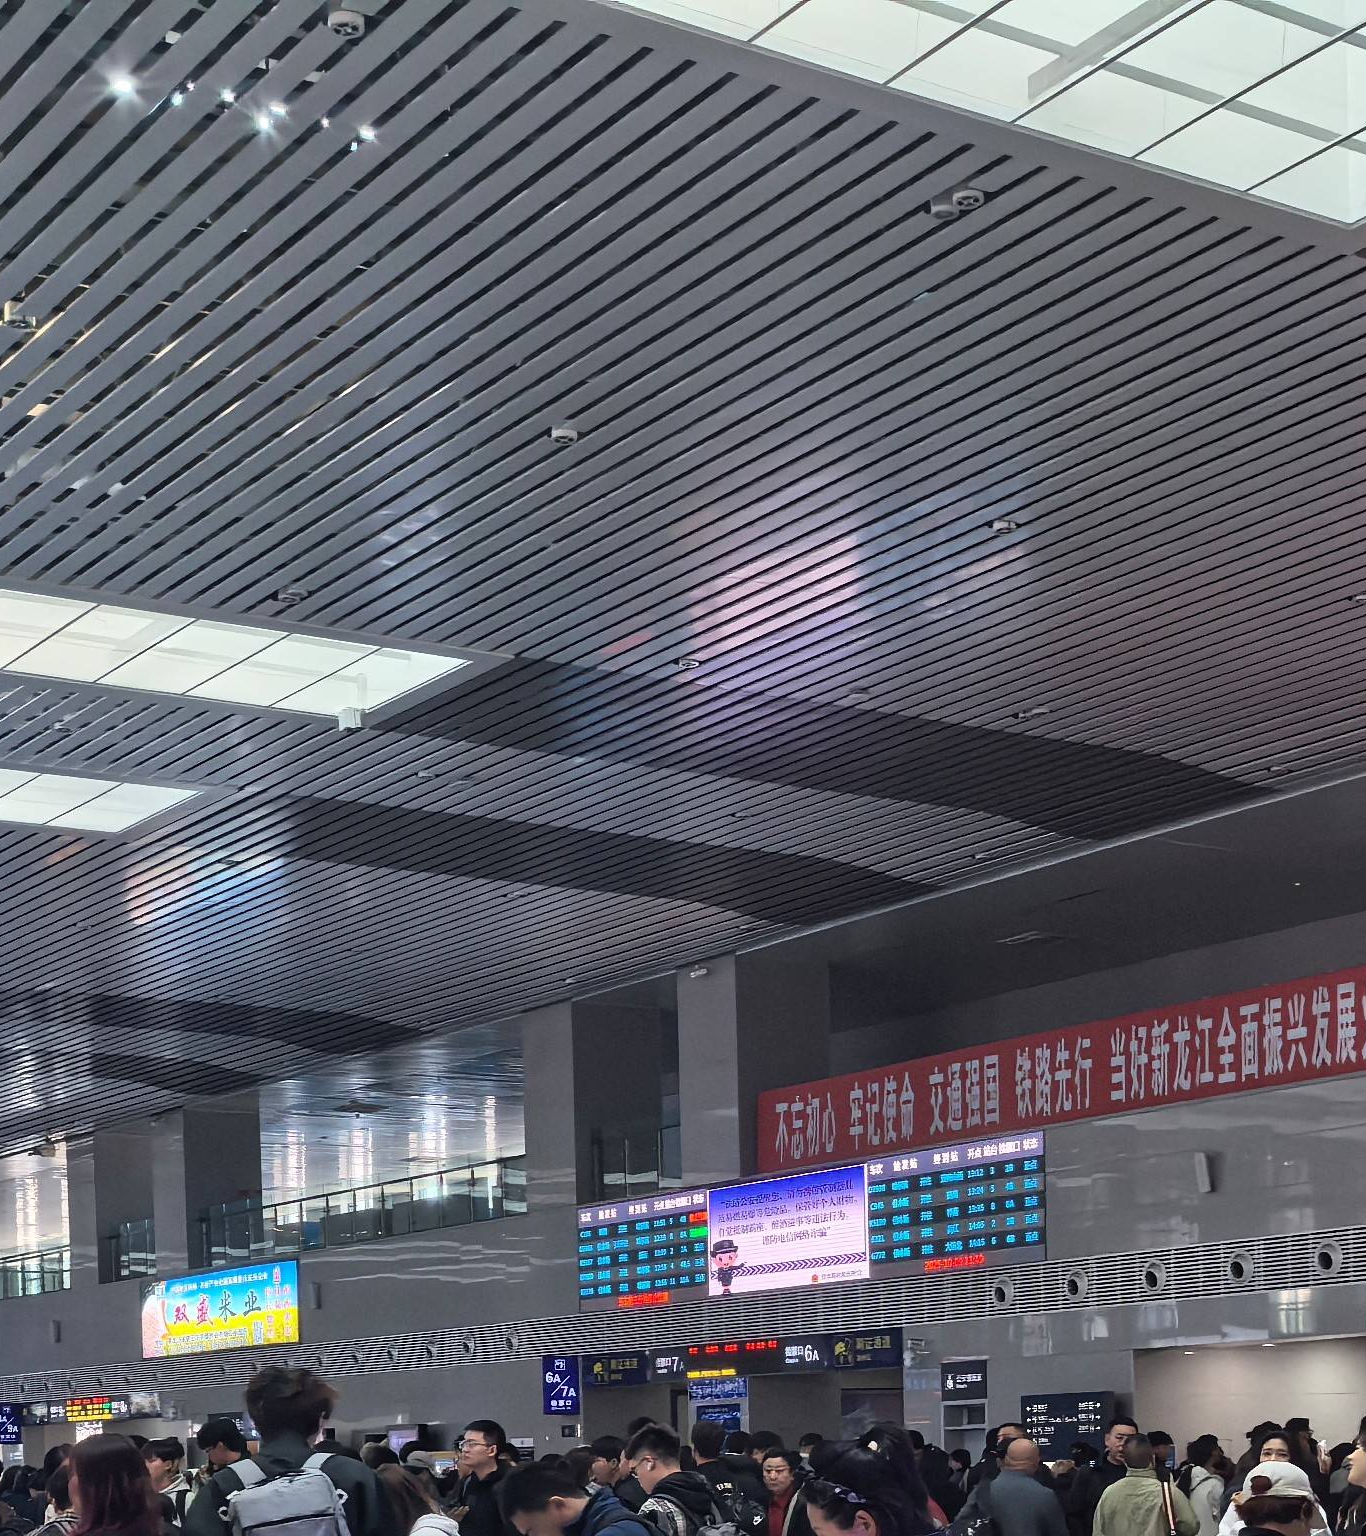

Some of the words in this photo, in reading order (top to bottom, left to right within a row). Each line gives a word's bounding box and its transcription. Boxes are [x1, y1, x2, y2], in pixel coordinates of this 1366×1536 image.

[775, 1092, 836, 1163] 不忘初心
[849, 1071, 915, 1150] 牢记使命
[928, 1054, 1000, 1136] 交通强国
[1015, 1035, 1092, 1119] 铁路先行
[804, 1345, 819, 1361] 6A
[545, 1372, 561, 1383] 6A
[561, 1386, 576, 1397] 7A
